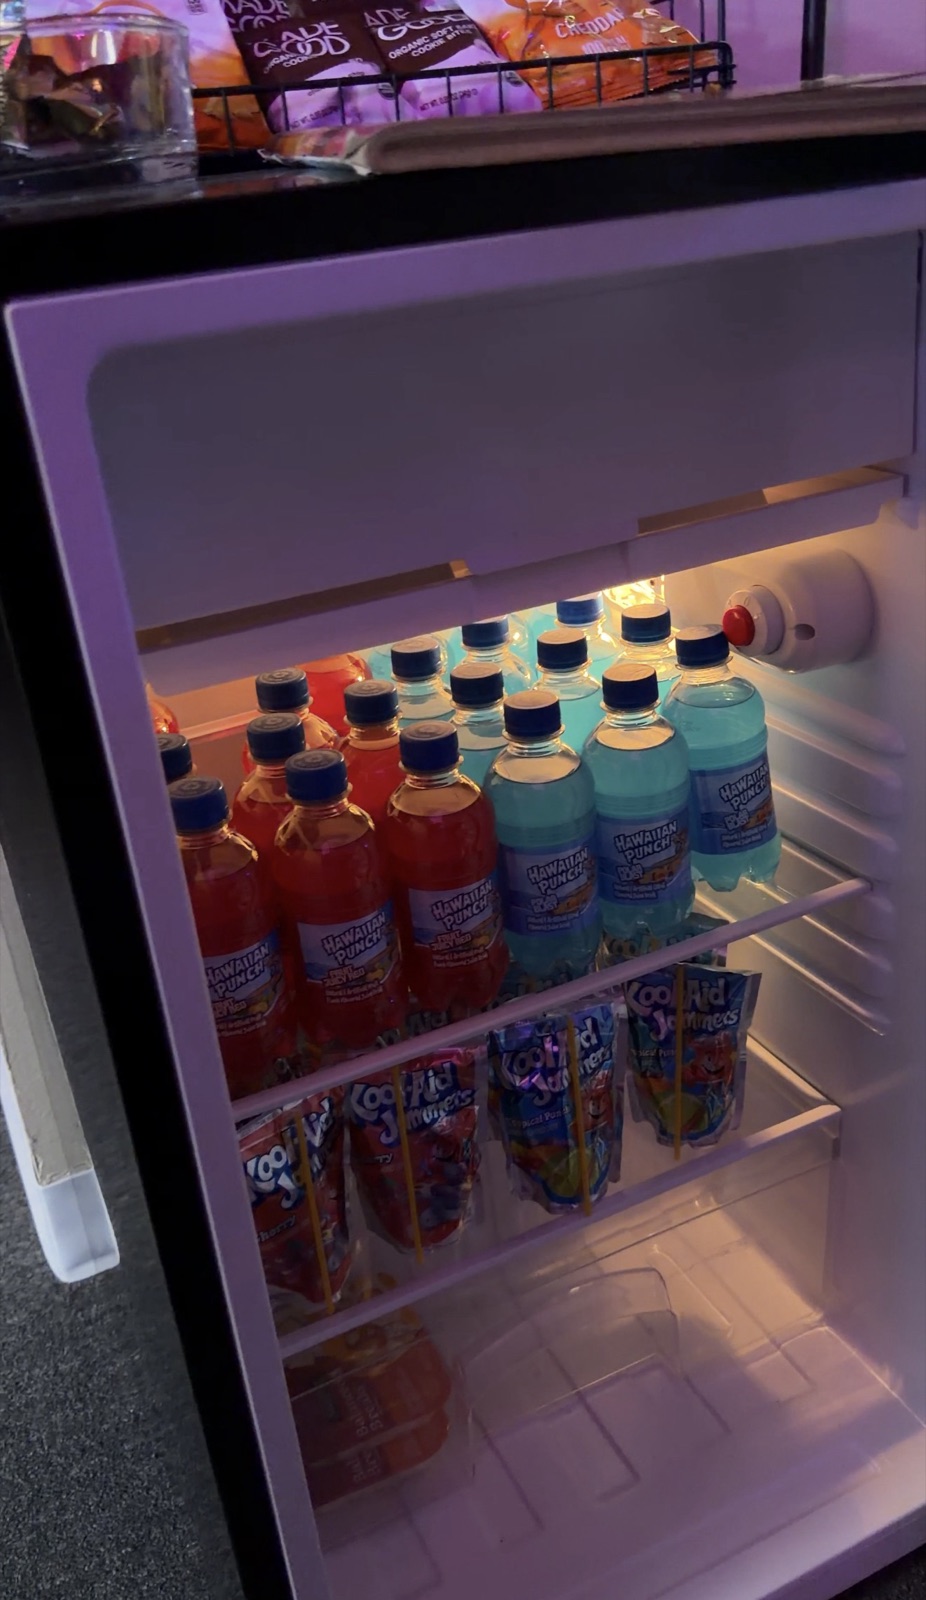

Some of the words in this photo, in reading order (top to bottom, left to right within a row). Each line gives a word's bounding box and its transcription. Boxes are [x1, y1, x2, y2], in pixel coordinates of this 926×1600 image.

[364, 8, 411, 27] ADE
[377, 14, 470, 41] GOOD
[388, 35, 430, 59] ORGANIC
[430, 25, 454, 40] SOFT
[411, 38, 446, 57] COOKIE
[730, 780, 767, 811] PUNCH
[614, 820, 677, 853] HAWAIIAN
[625, 835, 672, 864] PUNCH
[527, 848, 588, 884] HAWAIIAN
[538, 863, 584, 895] PUNCH
[432, 879, 493, 921] HAWAIIAN
[444, 897, 489, 931] PUNCH
[322, 911, 386, 956] HAWAIIAN
[335, 930, 382, 965] PUNCH
[206, 943, 271, 987] HAWAIIAN
[215, 960, 266, 997] PUNCH
